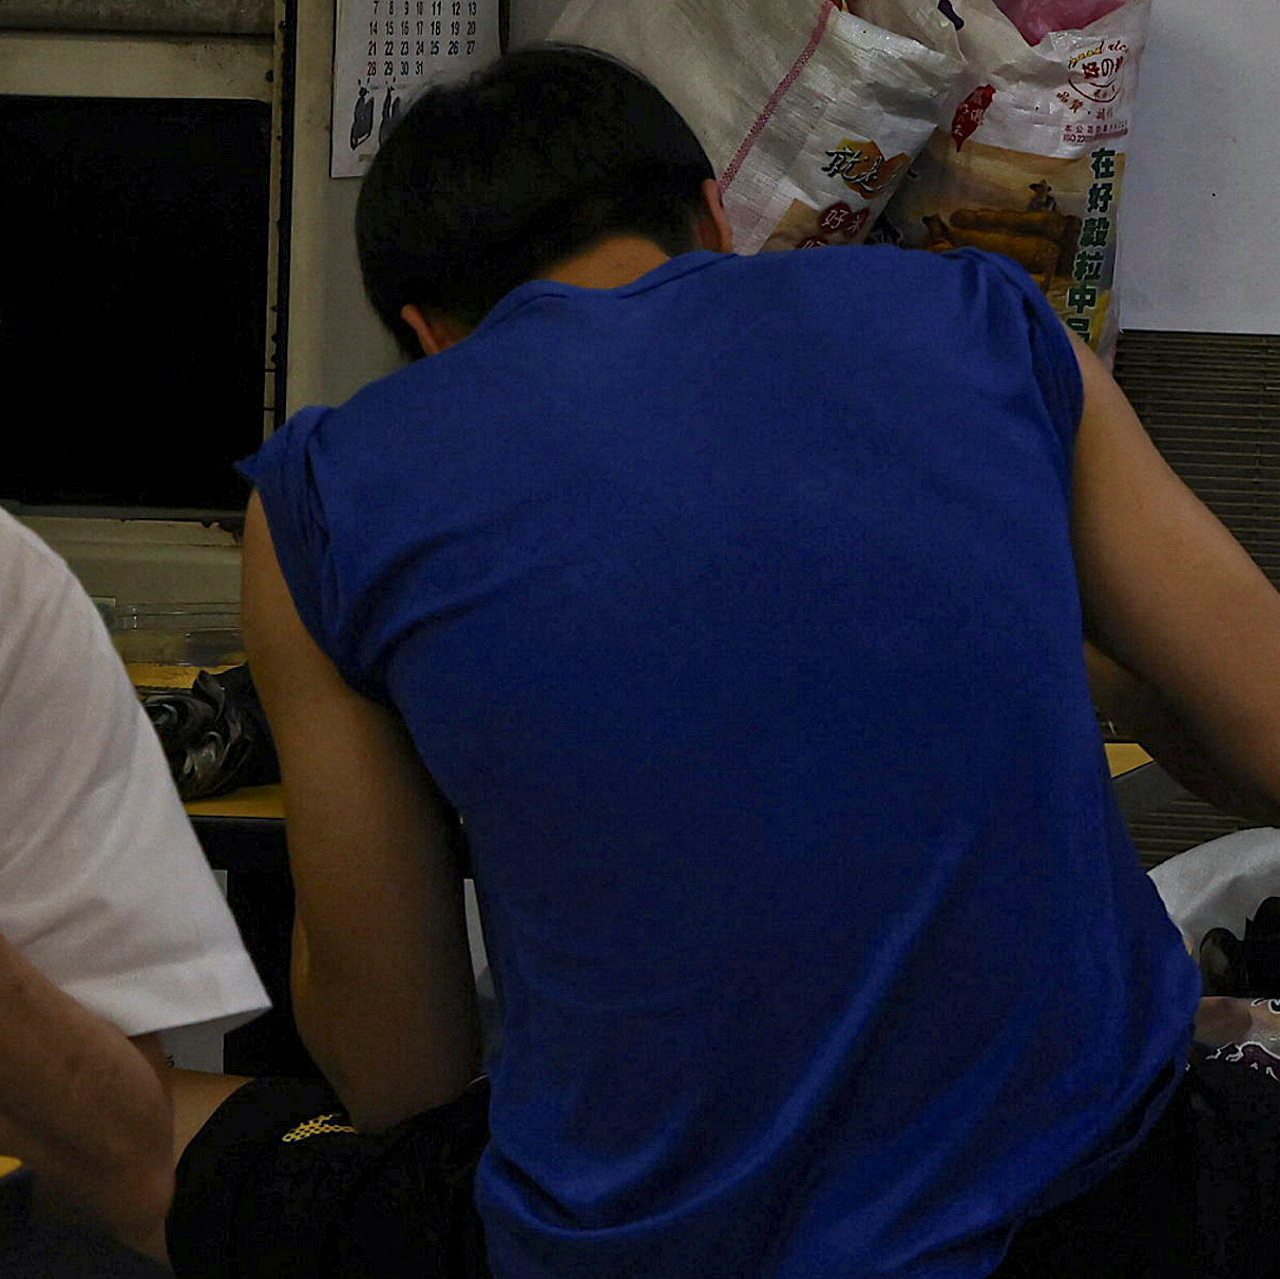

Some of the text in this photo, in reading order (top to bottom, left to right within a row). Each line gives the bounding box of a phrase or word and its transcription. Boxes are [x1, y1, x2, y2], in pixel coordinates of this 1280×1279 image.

[374, 0, 379, 14] 7
[389, 1, 394, 15] 8
[404, 1, 409, 15] 9
[432, 1, 442, 15] 11
[452, 1, 460, 15] 12
[468, 2, 476, 16] 13
[369, 21, 476, 36] 14 15 16 17 18 19 20
[368, 40, 475, 56] 21 22 23 24 25 26 27
[367, 61, 423, 76] 28 29 30 31
